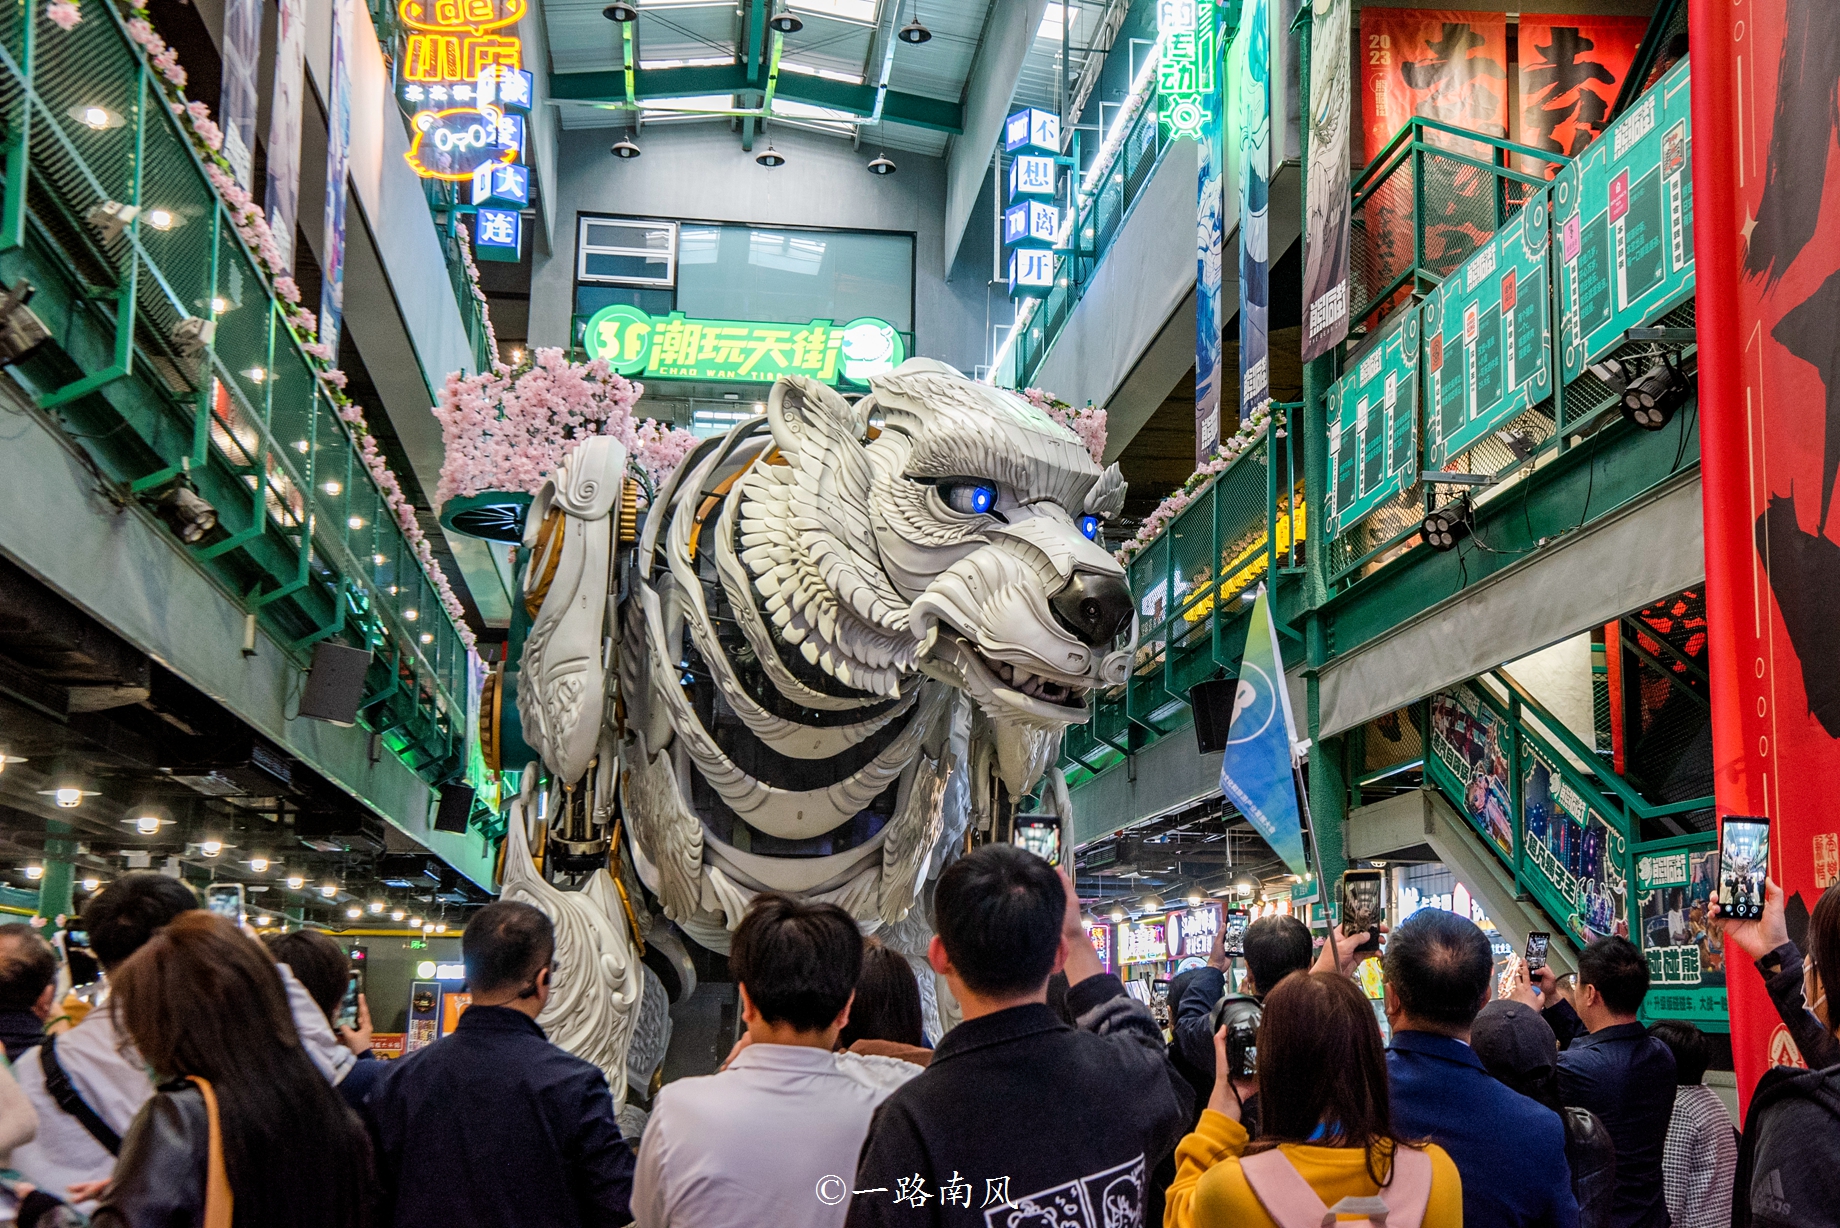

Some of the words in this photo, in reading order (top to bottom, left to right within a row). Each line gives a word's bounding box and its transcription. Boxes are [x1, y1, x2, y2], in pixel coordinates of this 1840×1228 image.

[404, 35, 521, 82] 小店
[1369, 34, 1390, 49] 20
[1369, 51, 1391, 65] 23
[1022, 119, 1055, 282] 不想离开
[647, 319, 845, 379] 潮玩天街
[659, 367, 697, 376] CHAO
[706, 369, 735, 378] WAN
[1645, 946, 1701, 983] 碰碰熊
